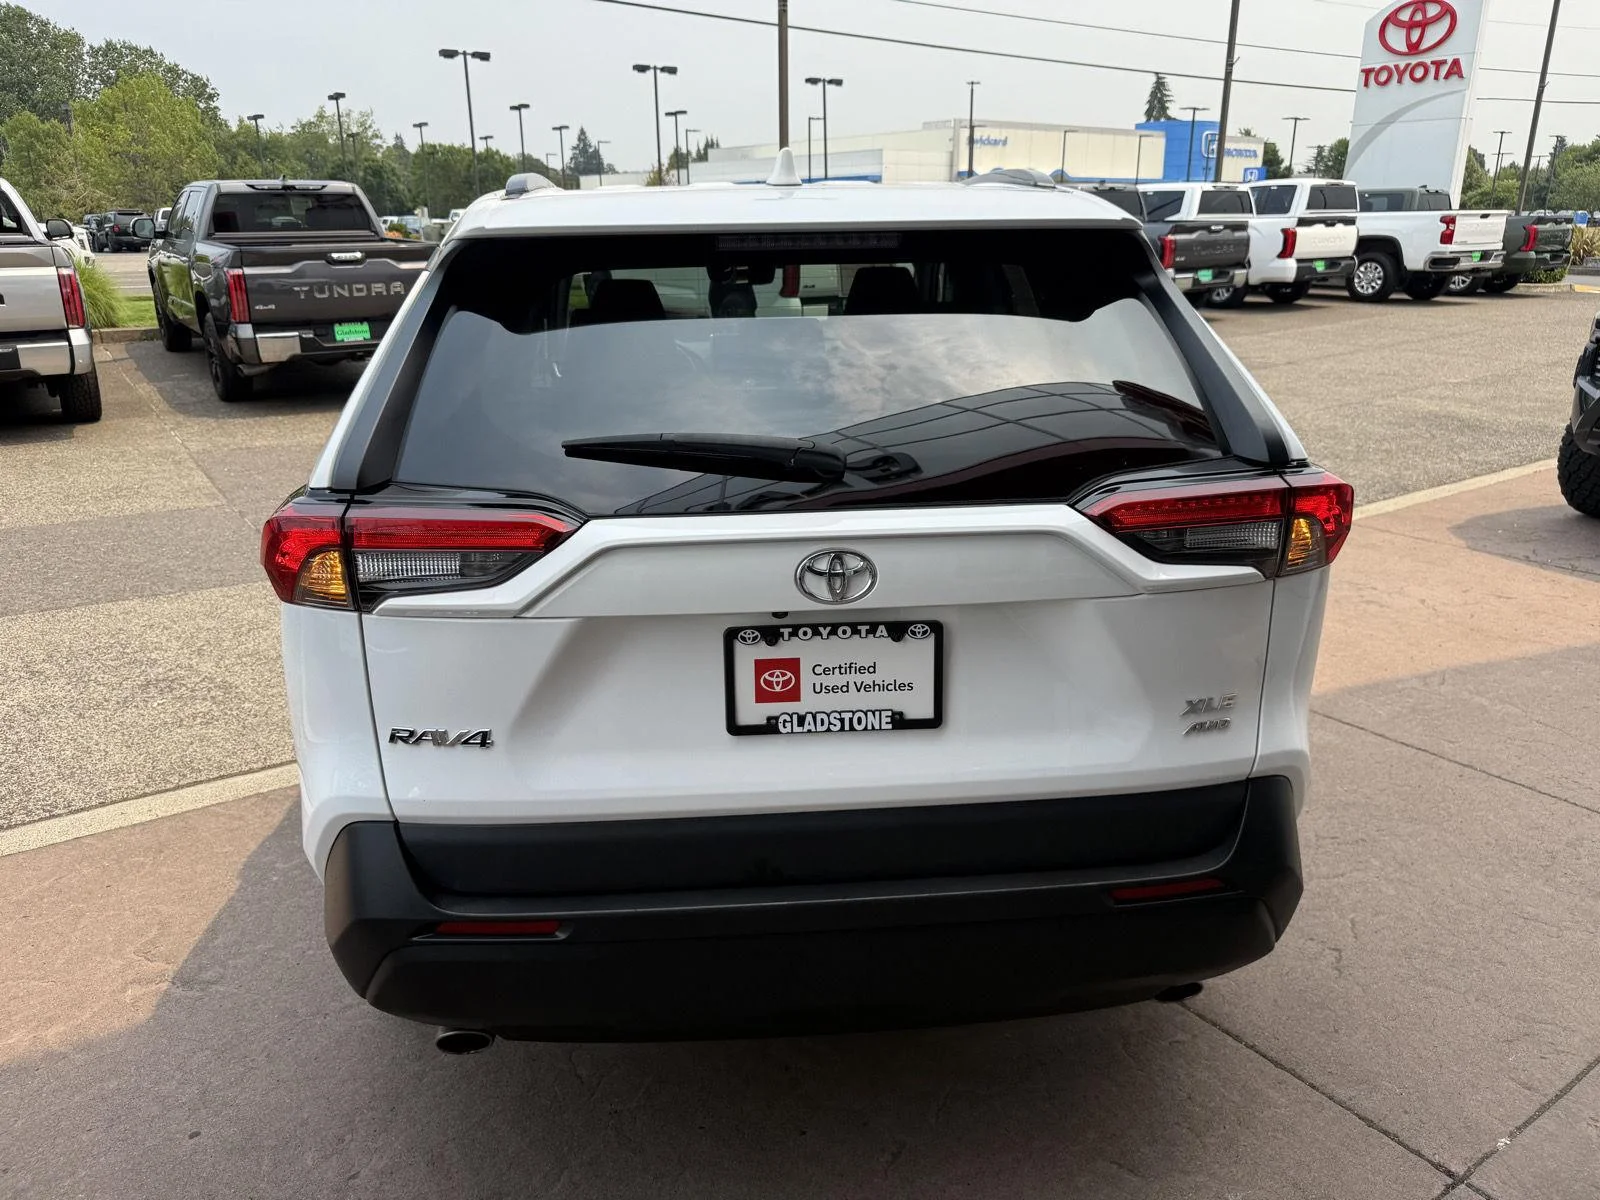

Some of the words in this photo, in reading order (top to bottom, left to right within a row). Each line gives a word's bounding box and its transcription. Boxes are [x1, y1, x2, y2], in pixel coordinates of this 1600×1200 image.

[1361, 58, 1464, 88] TOYOTA
[293, 281, 406, 299] TUNDRA
[780, 625, 889, 640] TOYOTA
[812, 662, 876, 676] Certified
[812, 681, 850, 695] Used
[853, 679, 914, 693] Vehicles
[1179, 693, 1238, 716] XLE
[778, 710, 893, 734] GLADSTONE
[389, 726, 494, 749] RAV4
